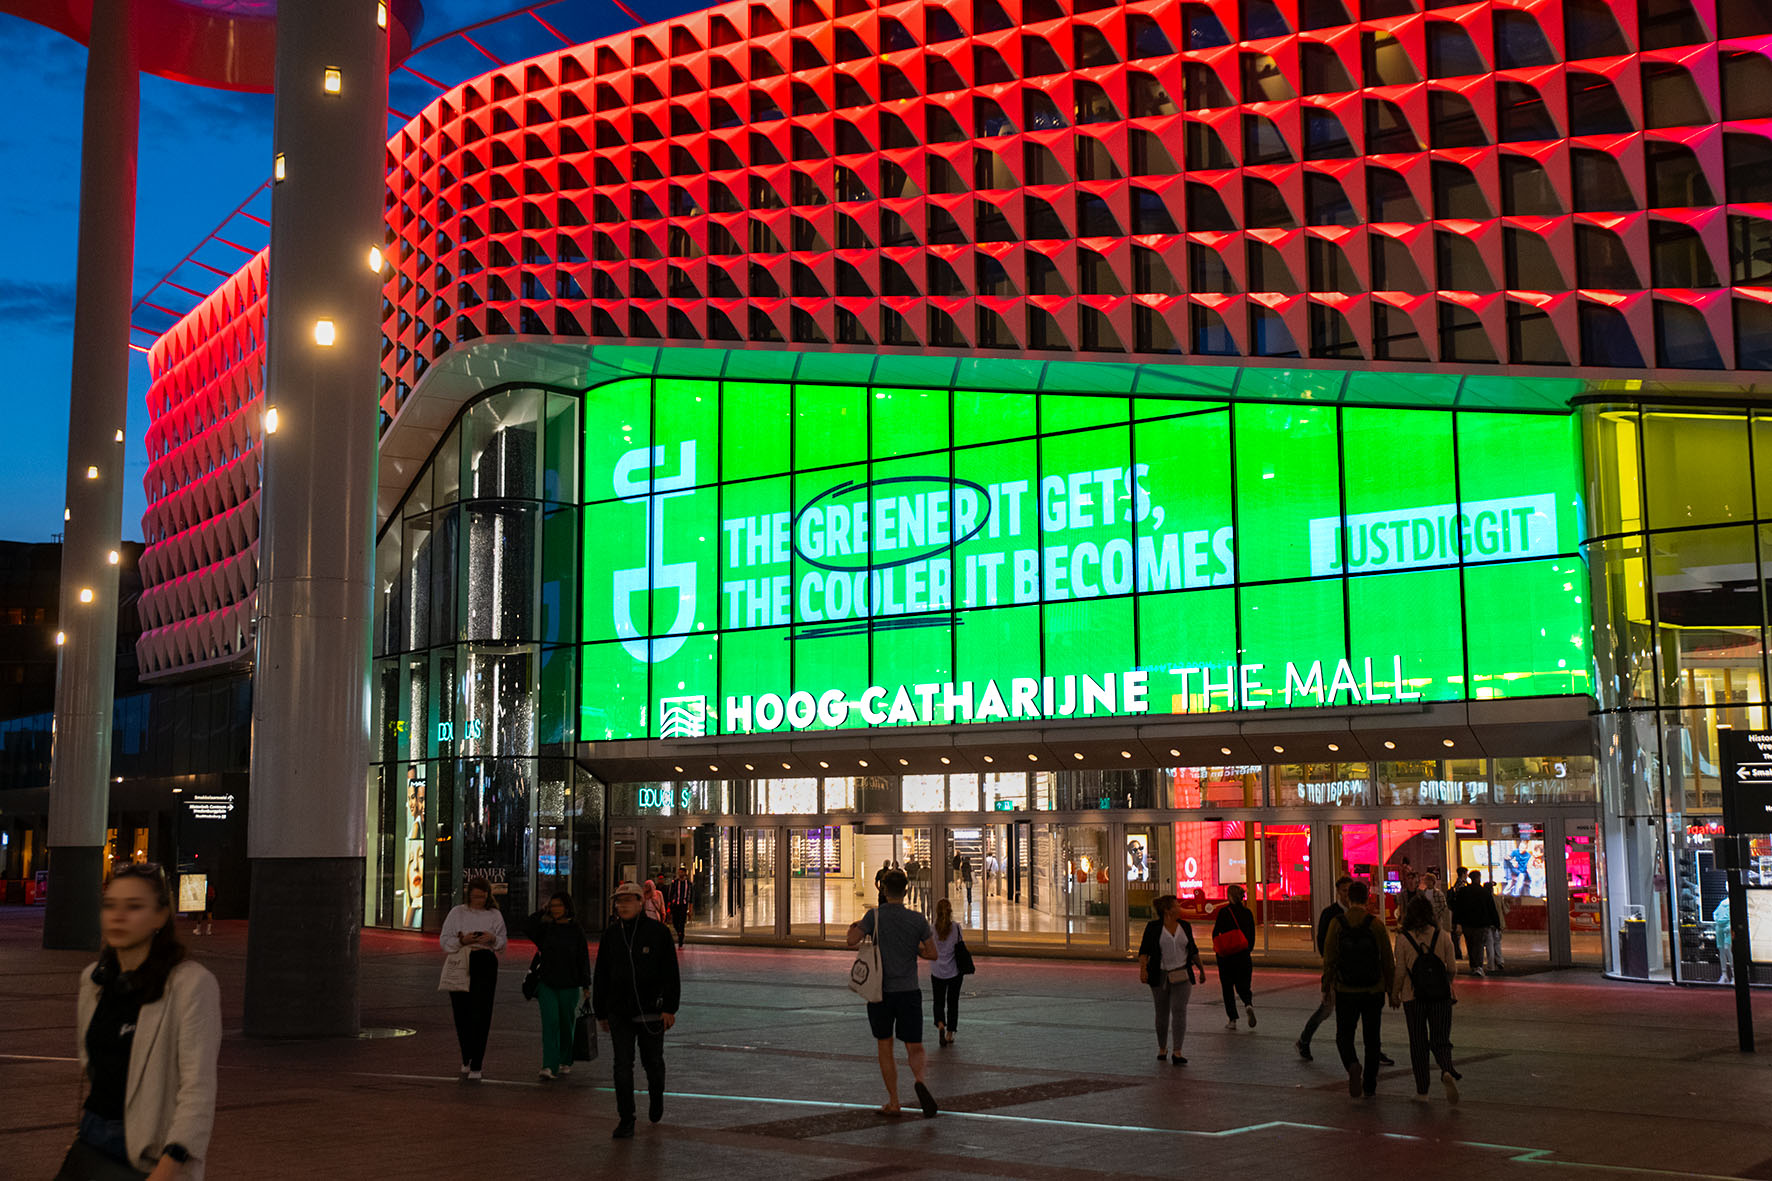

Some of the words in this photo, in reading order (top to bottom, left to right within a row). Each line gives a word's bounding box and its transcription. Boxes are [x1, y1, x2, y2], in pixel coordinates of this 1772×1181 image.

[723, 511, 790, 568] THE
[800, 487, 980, 559] GREENER
[988, 480, 1028, 539] IT
[1037, 463, 1165, 532] GETS,
[1330, 506, 1536, 569] JUSTDIGGIT
[723, 575, 791, 629] THE
[800, 558, 951, 622] COOLER
[965, 552, 1005, 608] IT
[1013, 526, 1235, 604] BECOMES
[726, 689, 848, 732] HOOG
[860, 671, 1150, 724] CATHARIJNE
[1169, 663, 1266, 709] THE
[1285, 655, 1422, 705] MALL
[638, 787, 689, 809] DOUGLS
